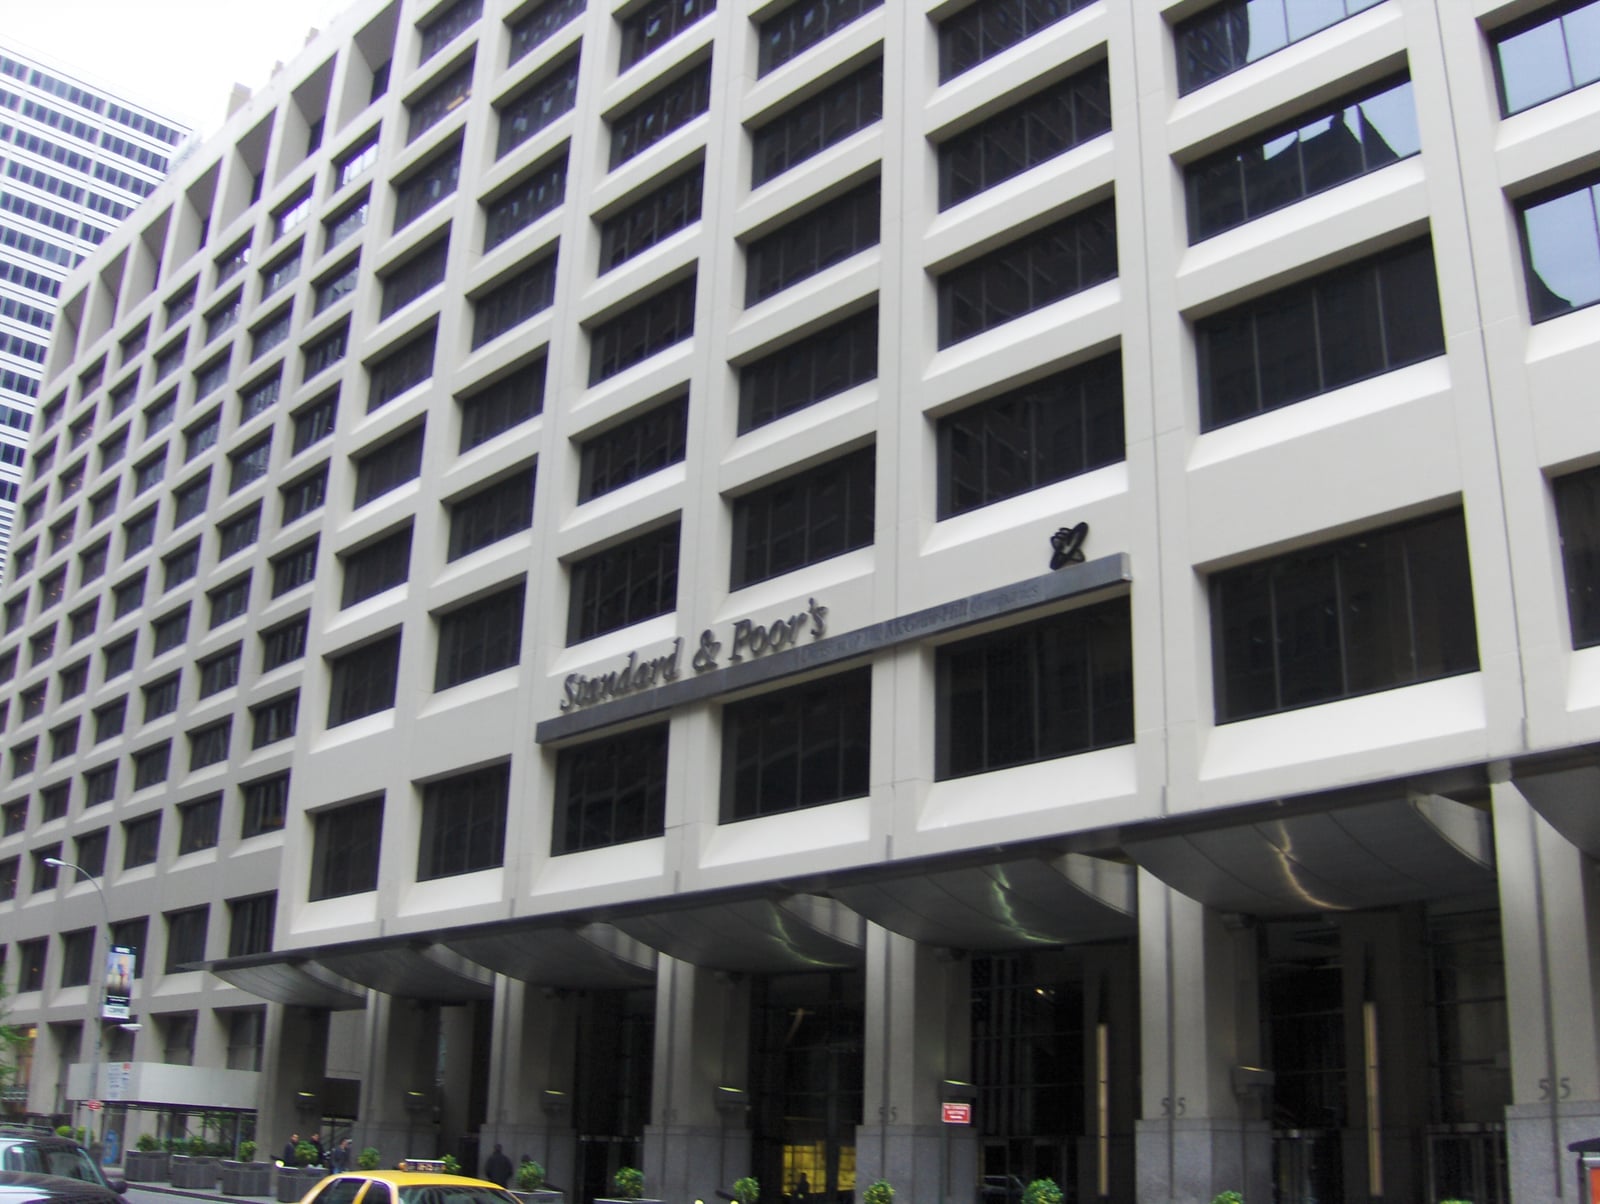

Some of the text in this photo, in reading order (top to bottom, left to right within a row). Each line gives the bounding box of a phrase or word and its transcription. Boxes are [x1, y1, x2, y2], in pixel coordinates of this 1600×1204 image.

[560, 637, 684, 712] Standard
[693, 629, 721, 673] &
[728, 597, 828, 663] Poor's
[1538, 1077, 1571, 1101] 55
